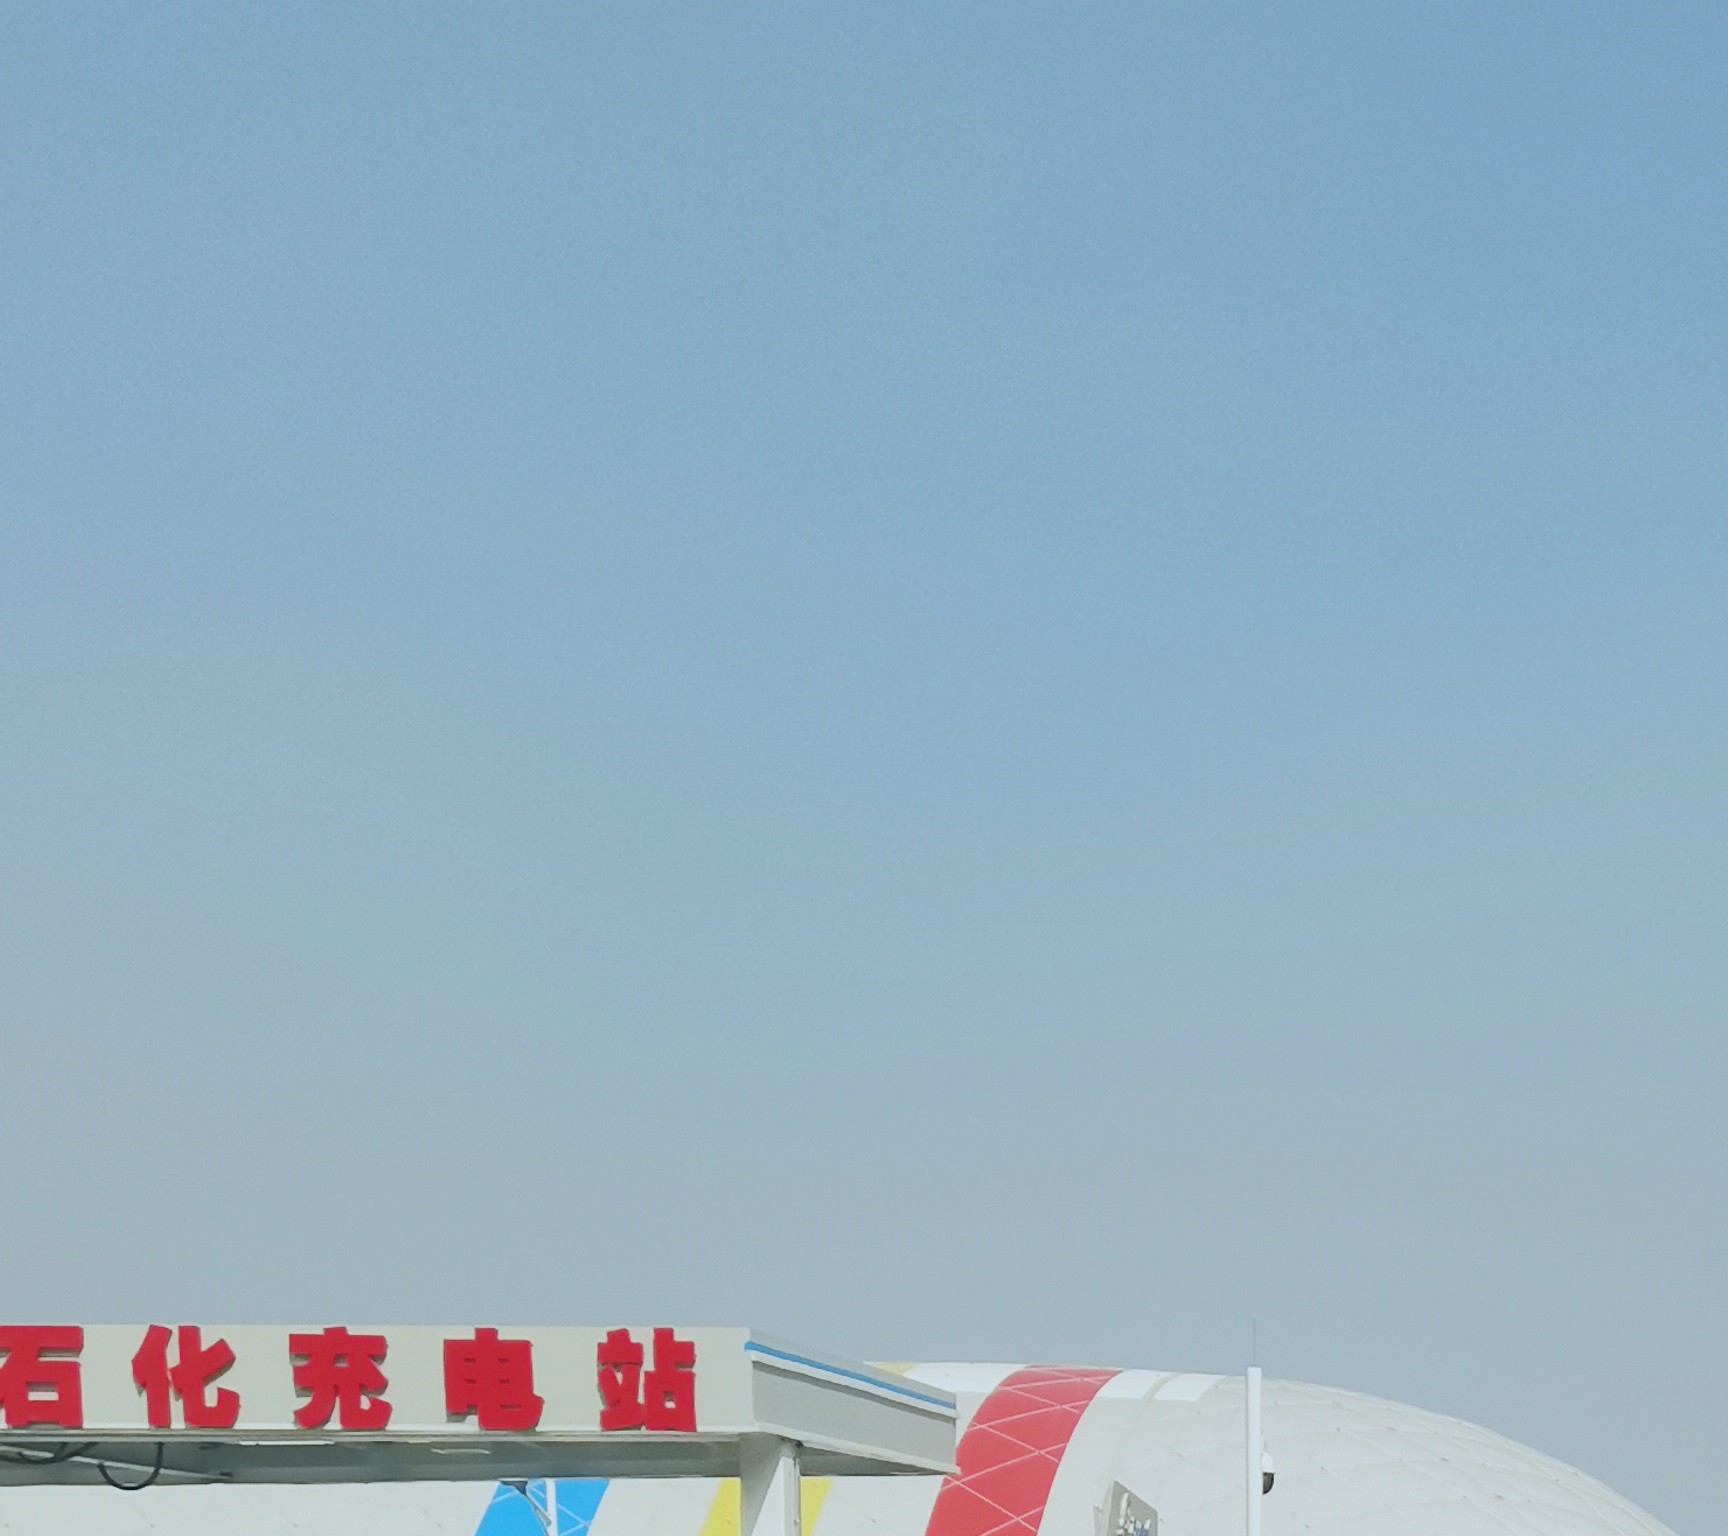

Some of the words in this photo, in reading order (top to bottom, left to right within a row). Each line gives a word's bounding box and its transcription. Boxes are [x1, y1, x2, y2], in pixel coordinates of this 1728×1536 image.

[0, 1325, 697, 1432] 石化充电站
